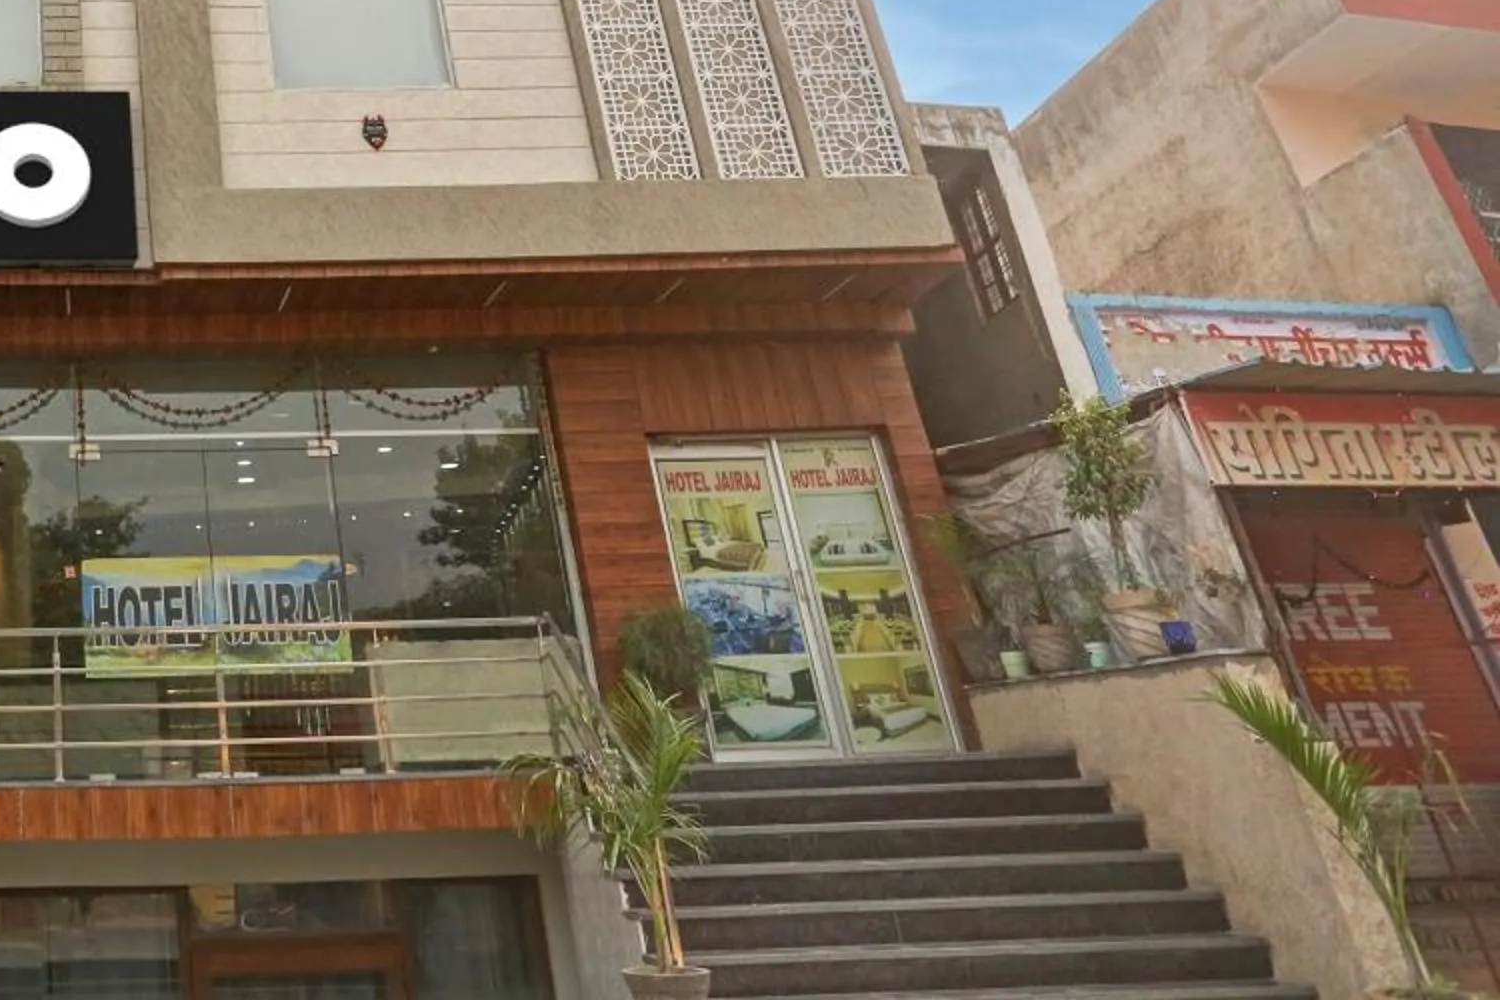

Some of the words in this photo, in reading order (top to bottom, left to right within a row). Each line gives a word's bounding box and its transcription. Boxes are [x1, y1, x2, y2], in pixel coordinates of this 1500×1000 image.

[663, 471, 711, 493] HOTEL
[714, 470, 762, 492] JAIRAJ
[789, 469, 833, 489] HOTEL
[835, 467, 876, 486] JAIRAJ
[92, 584, 204, 647] HOTEL
[222, 579, 342, 645] JAIRAJ
